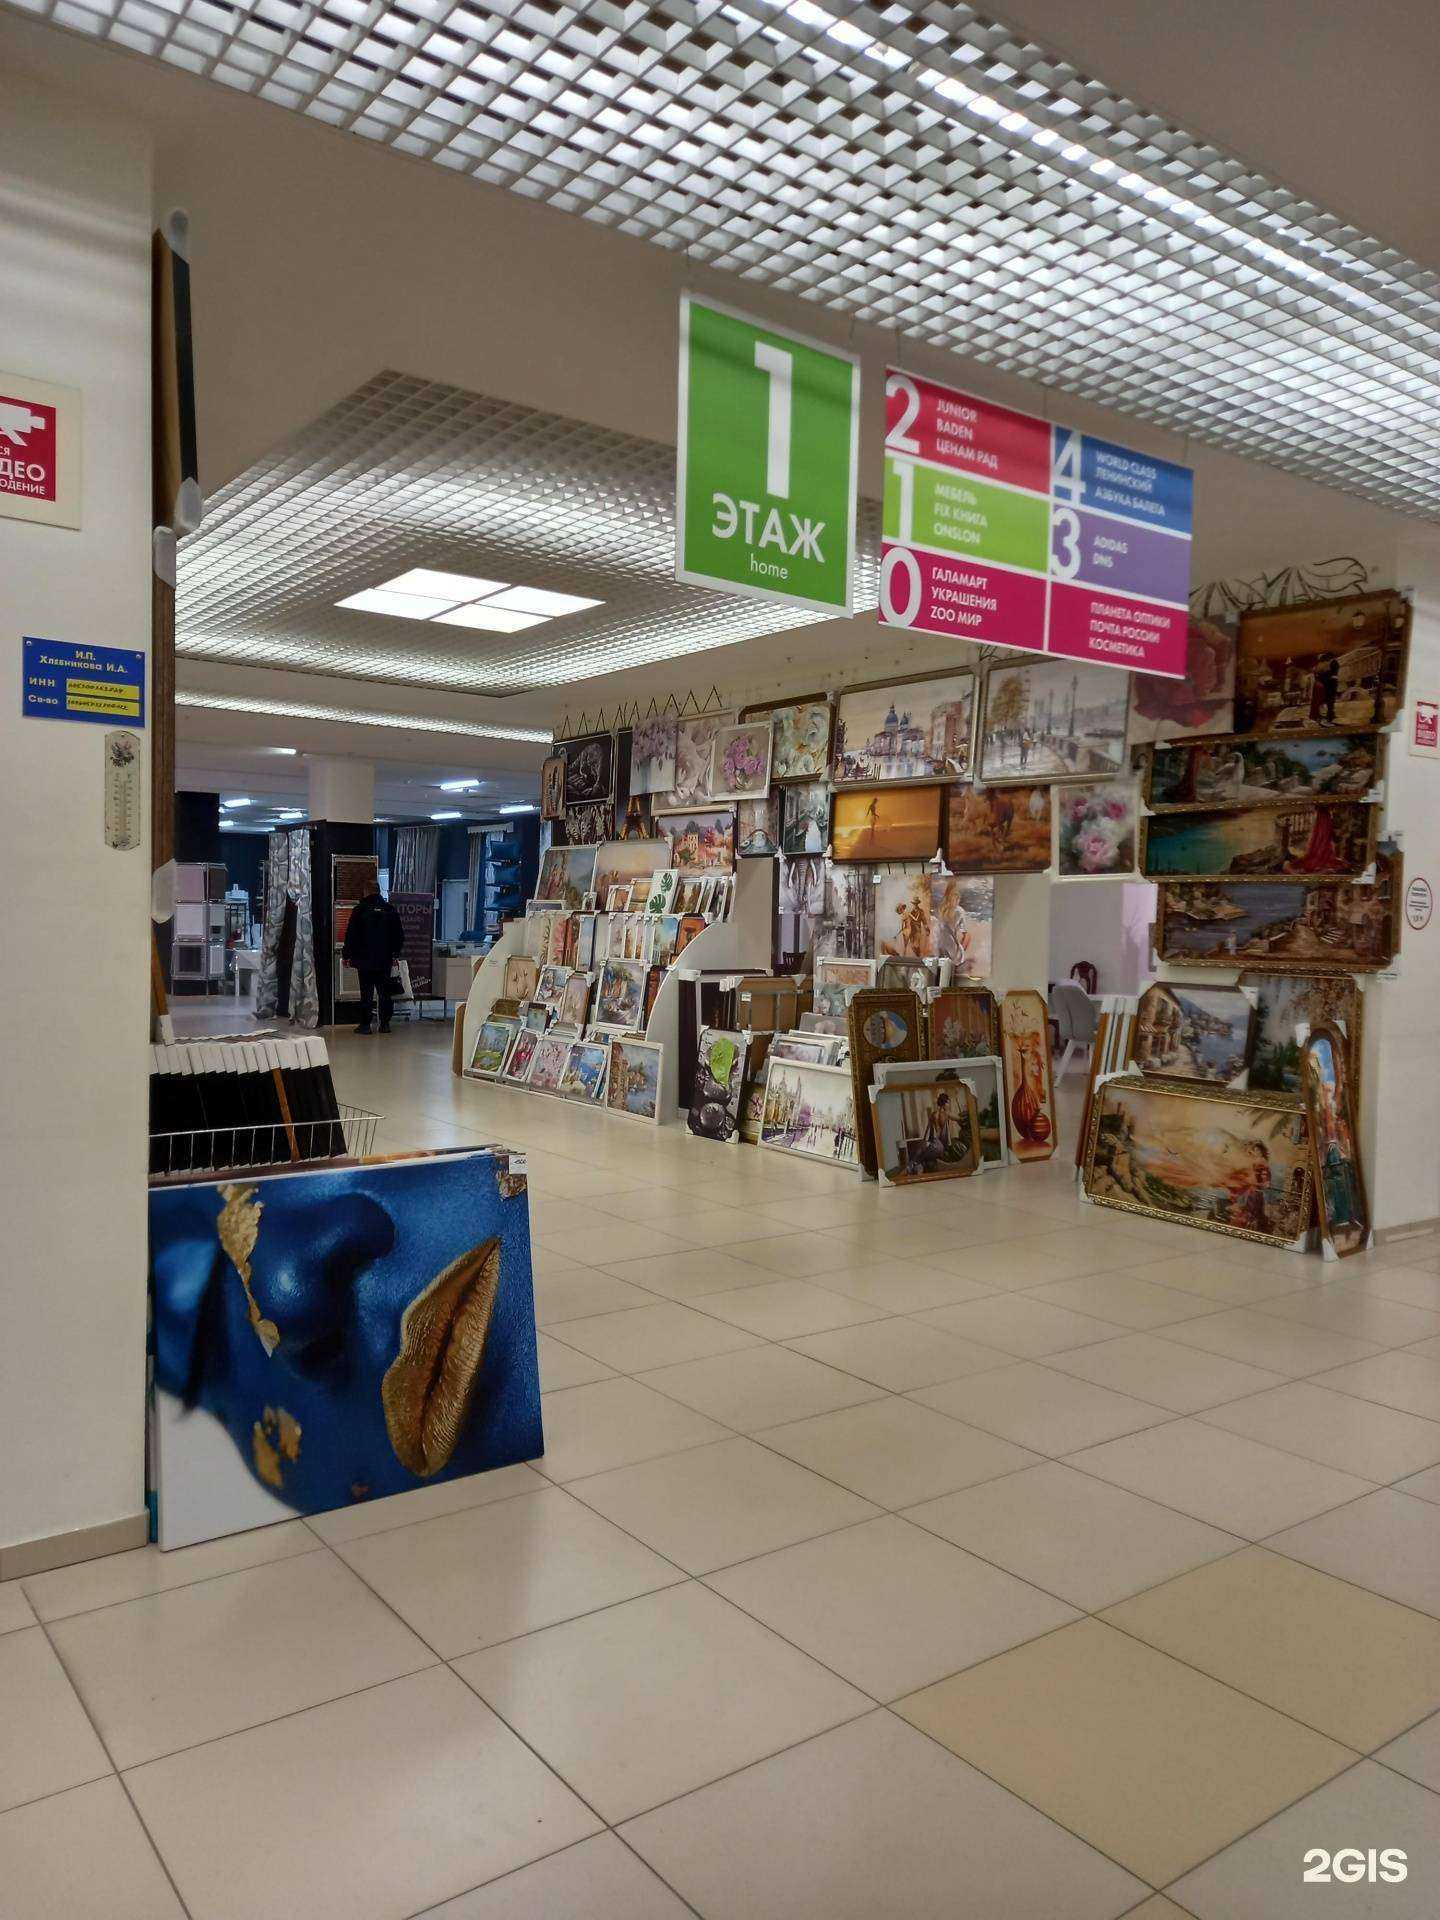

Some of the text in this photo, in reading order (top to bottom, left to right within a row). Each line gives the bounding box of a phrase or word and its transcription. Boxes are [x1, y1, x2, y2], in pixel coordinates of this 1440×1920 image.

[754, 340, 793, 500] 1
[885, 374, 920, 454] 2
[936, 400, 977, 423] JUNIOR
[936, 419, 973, 439] BADEN
[936, 438, 998, 470] ЦЕНАМ РАД
[1053, 430, 1087, 507] 4
[712, 492, 826, 563] ЭТАЖ
[893, 459, 914, 546] 1
[750, 554, 789, 580] home
[1051, 507, 1081, 580] 3
[879, 546, 922, 628] 0
[931, 586, 998, 612] УКРАШЕНИЯ
[932, 567, 988, 590] ГАЛАМАРТ
[930, 605, 983, 626] ZOO МИР
